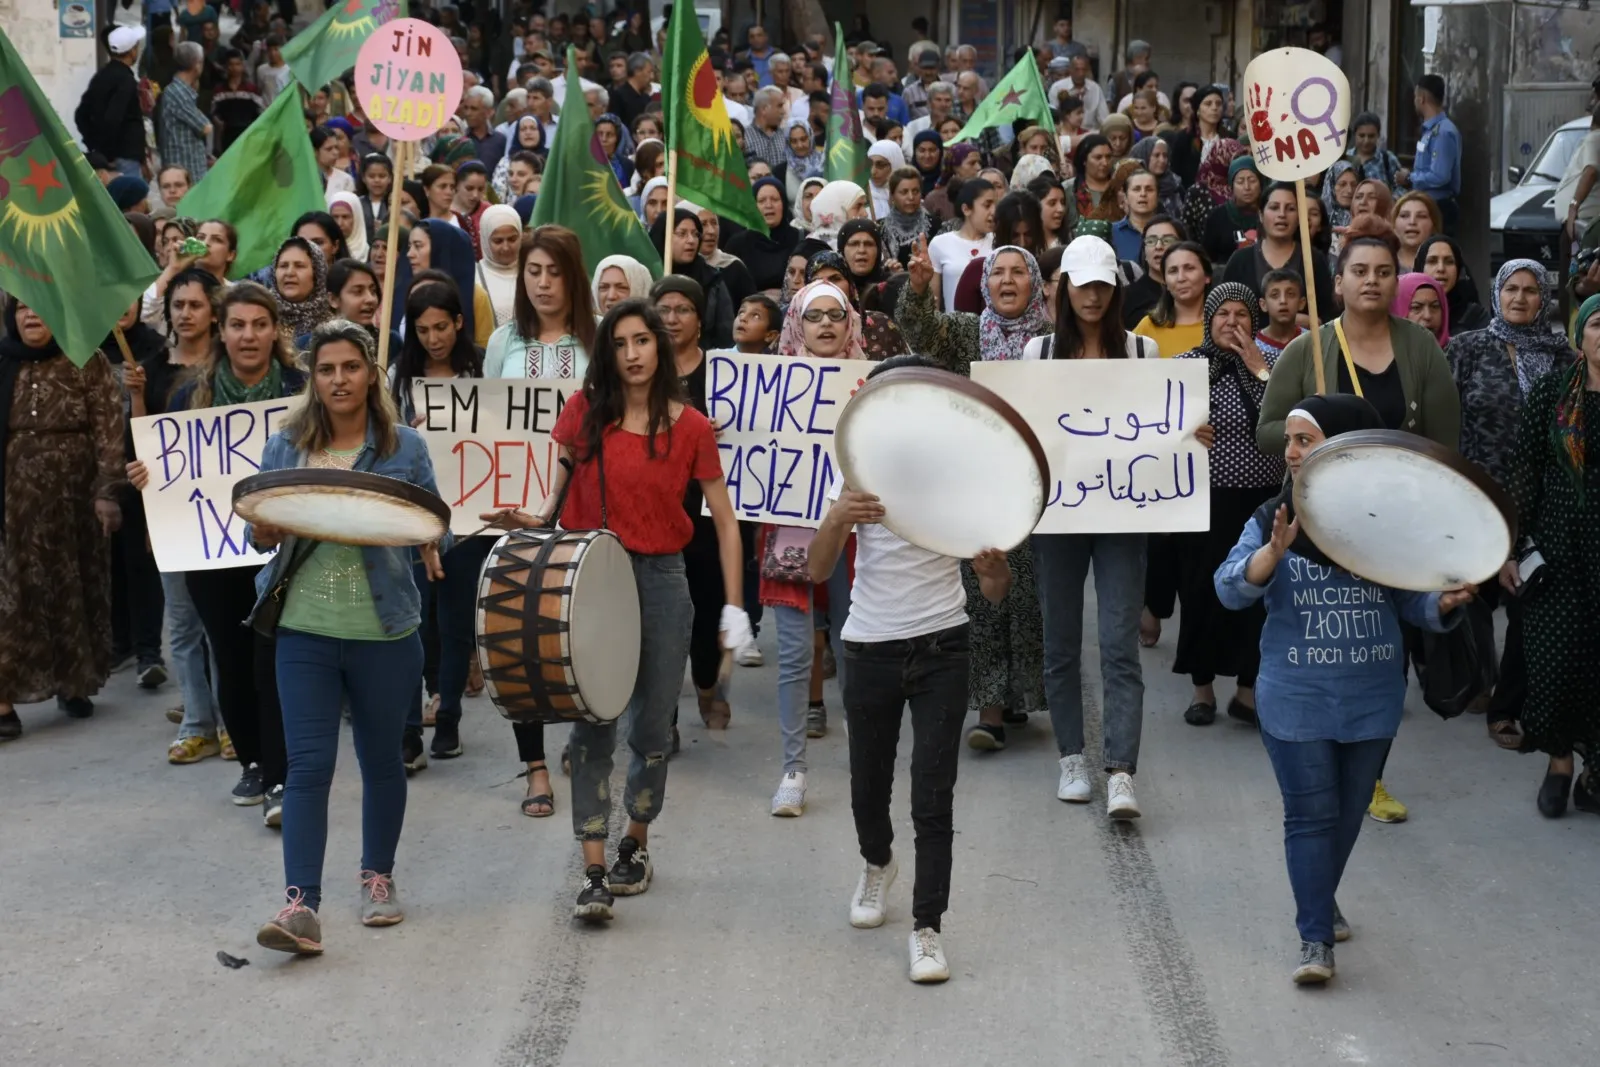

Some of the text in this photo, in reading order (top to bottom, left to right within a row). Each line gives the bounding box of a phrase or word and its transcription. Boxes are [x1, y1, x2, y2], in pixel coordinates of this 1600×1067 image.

[708, 356, 841, 435] BIMRE
[1057, 378, 1185, 442] الموت
[1046, 452, 1195, 509] للديكتاتور
[1287, 646, 1299, 665] a
[1350, 646, 1368, 664] to
